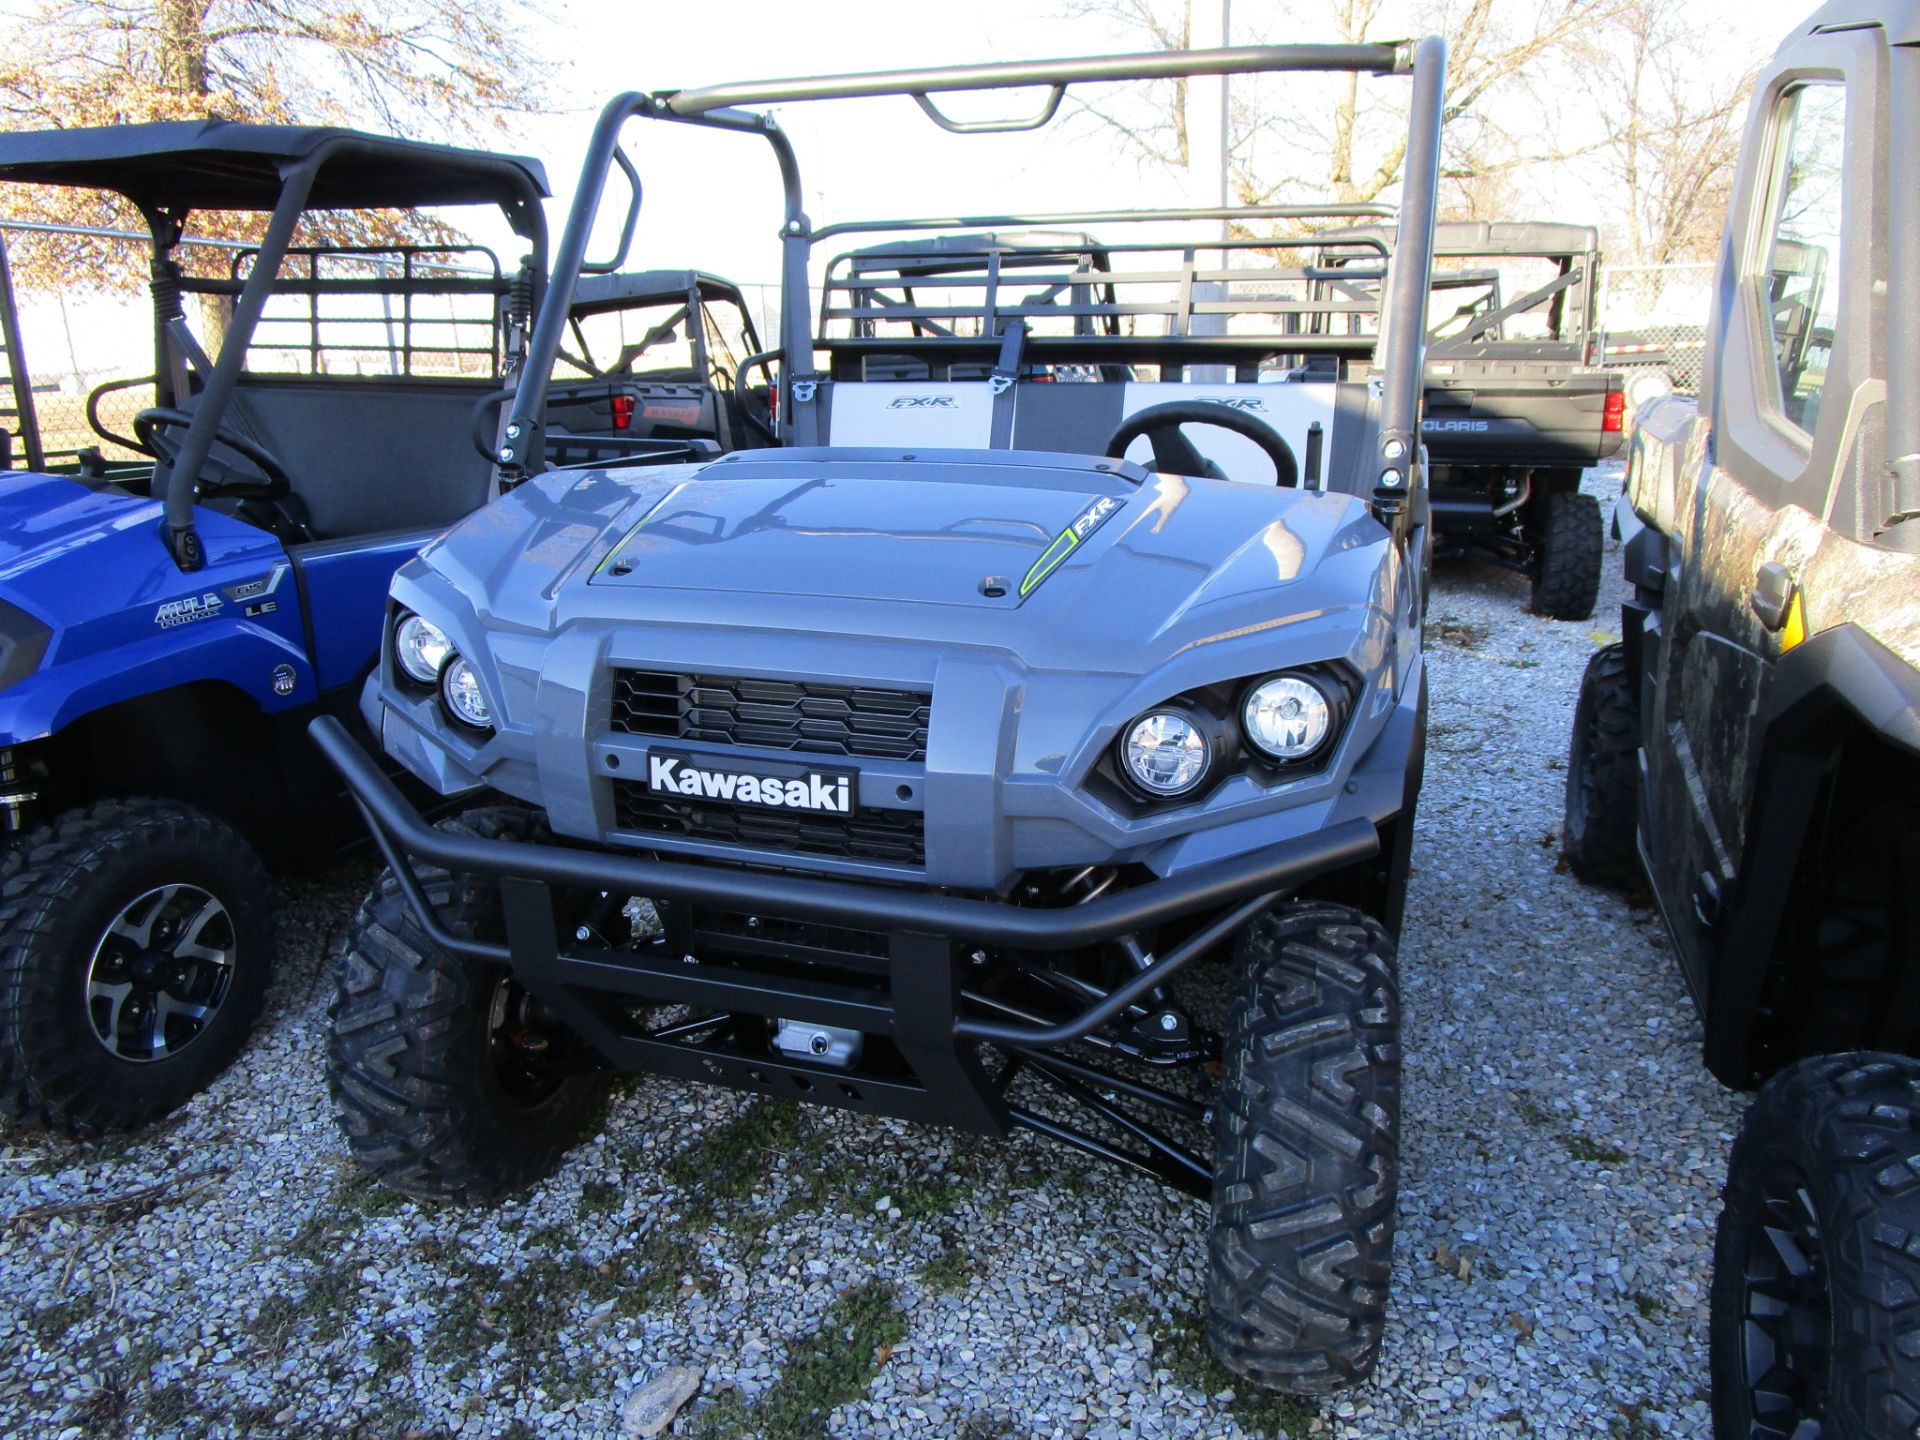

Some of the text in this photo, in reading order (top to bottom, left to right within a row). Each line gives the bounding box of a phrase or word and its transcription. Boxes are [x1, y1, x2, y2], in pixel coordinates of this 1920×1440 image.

[886, 395, 959, 409] FXR
[1194, 396, 1268, 412] XR
[1421, 421, 1489, 431] OLARIS
[1073, 497, 1116, 537] FXR
[154, 592, 224, 622] MULE
[245, 601, 278, 617] LE
[650, 756, 849, 812] Kawasaki
